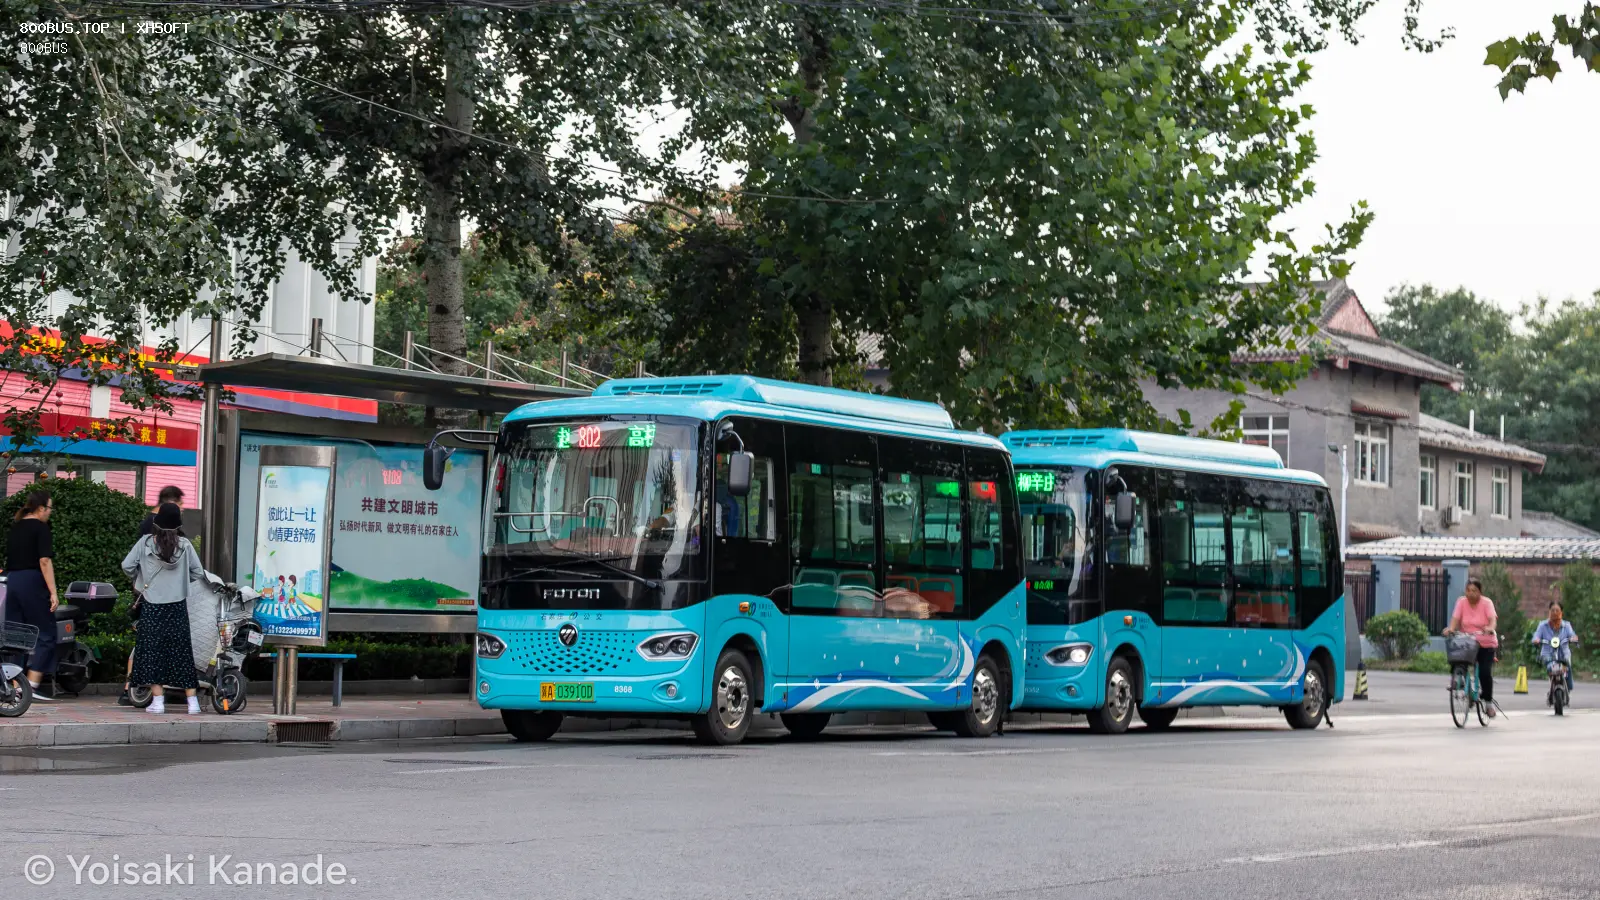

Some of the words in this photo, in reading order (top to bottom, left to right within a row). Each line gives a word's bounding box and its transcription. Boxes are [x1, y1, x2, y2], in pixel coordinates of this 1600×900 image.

[140, 426, 167, 445] 救援
[578, 426, 600, 448] 802
[268, 506, 317, 523] 彼此让一让
[361, 497, 438, 516] 共建文明城市
[268, 527, 316, 543] 心情更舒畅
[340, 520, 382, 533] 弘扬时代新风
[387, 522, 459, 537] 做文明有礼的石家庄人
[543, 588, 600, 599] FOTON
